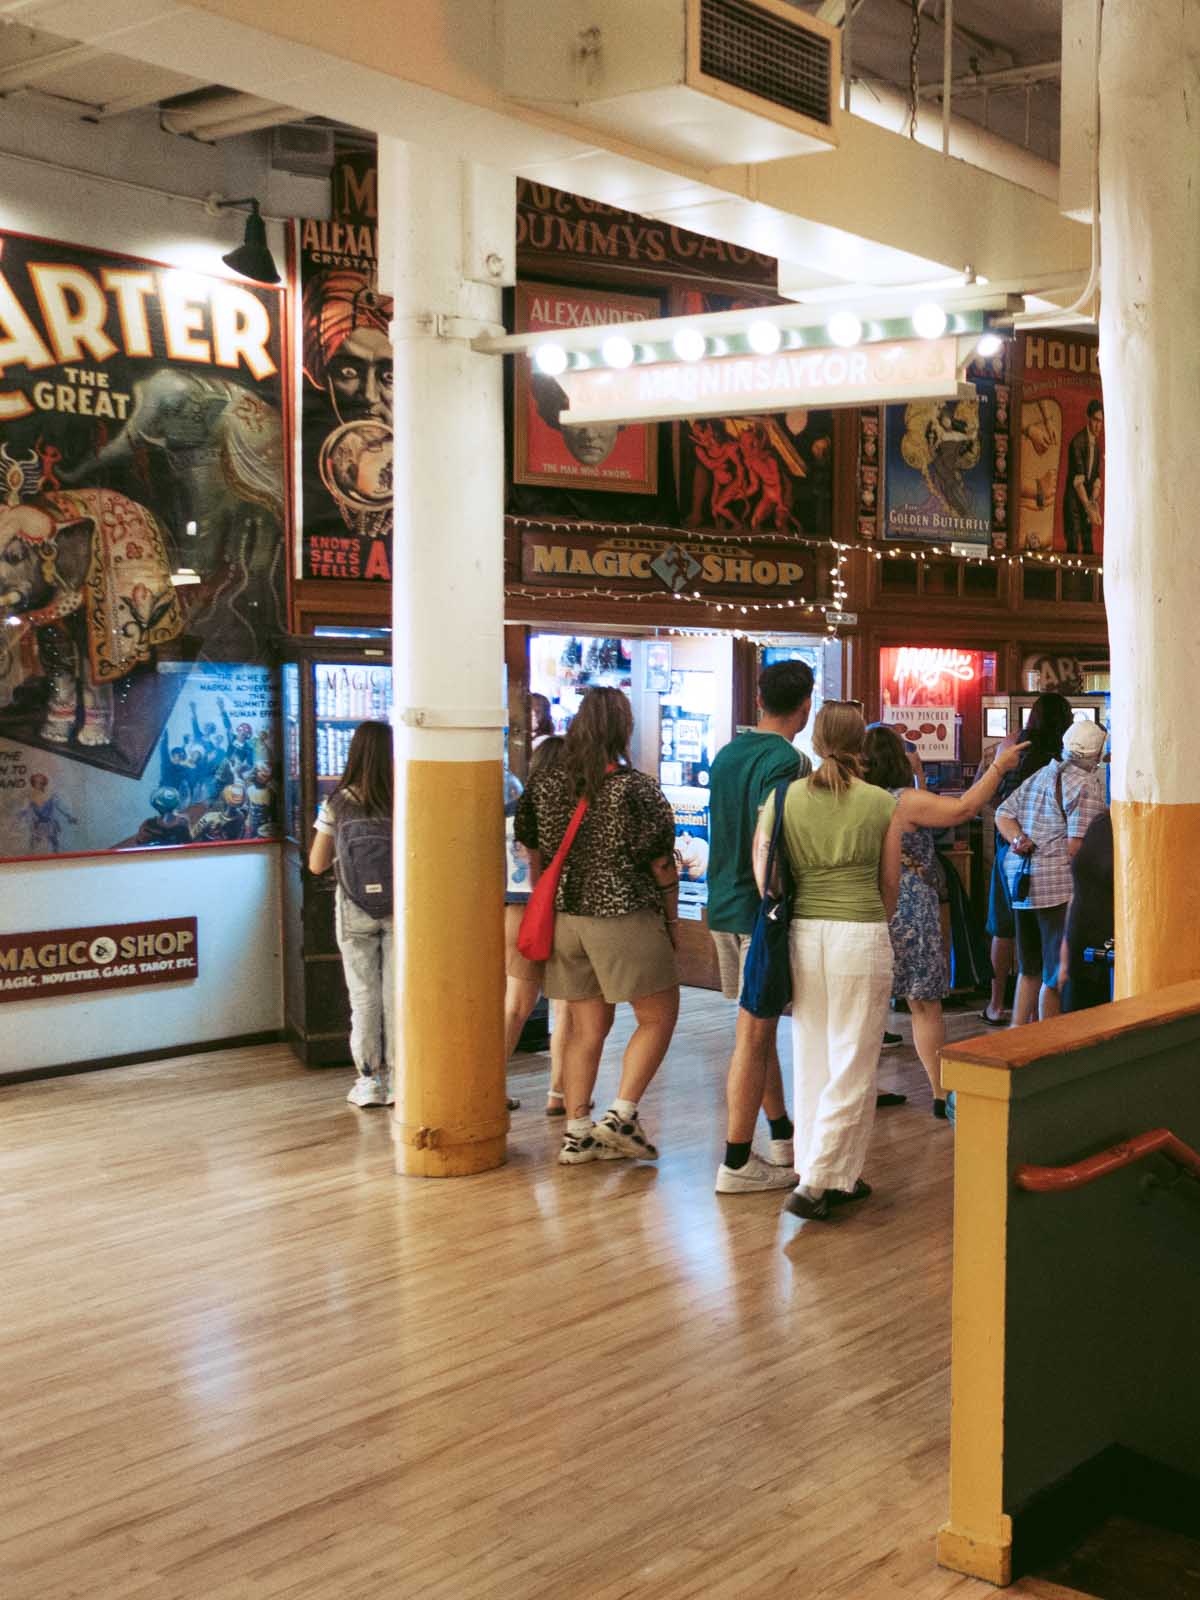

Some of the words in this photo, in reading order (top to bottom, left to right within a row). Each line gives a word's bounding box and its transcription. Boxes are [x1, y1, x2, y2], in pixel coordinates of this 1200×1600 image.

[303, 218, 378, 258] ALEXA
[0, 259, 278, 383] ARTER
[63, 367, 109, 386] THE
[33, 381, 130, 420] GREAT
[889, 509, 929, 526] GOLDEN
[932, 513, 990, 531] BUTTERFLY
[310, 535, 361, 550] KNOWS
[310, 550, 361, 564] SEES
[364, 540, 391, 579] A
[531, 545, 652, 578] MAGIC
[701, 554, 804, 587] SHOP
[311, 563, 361, 578] TELLS
[891, 711, 914, 721] PENNY
[918, 711, 949, 721] PINCHER
[120, 930, 194, 960] SHOP
